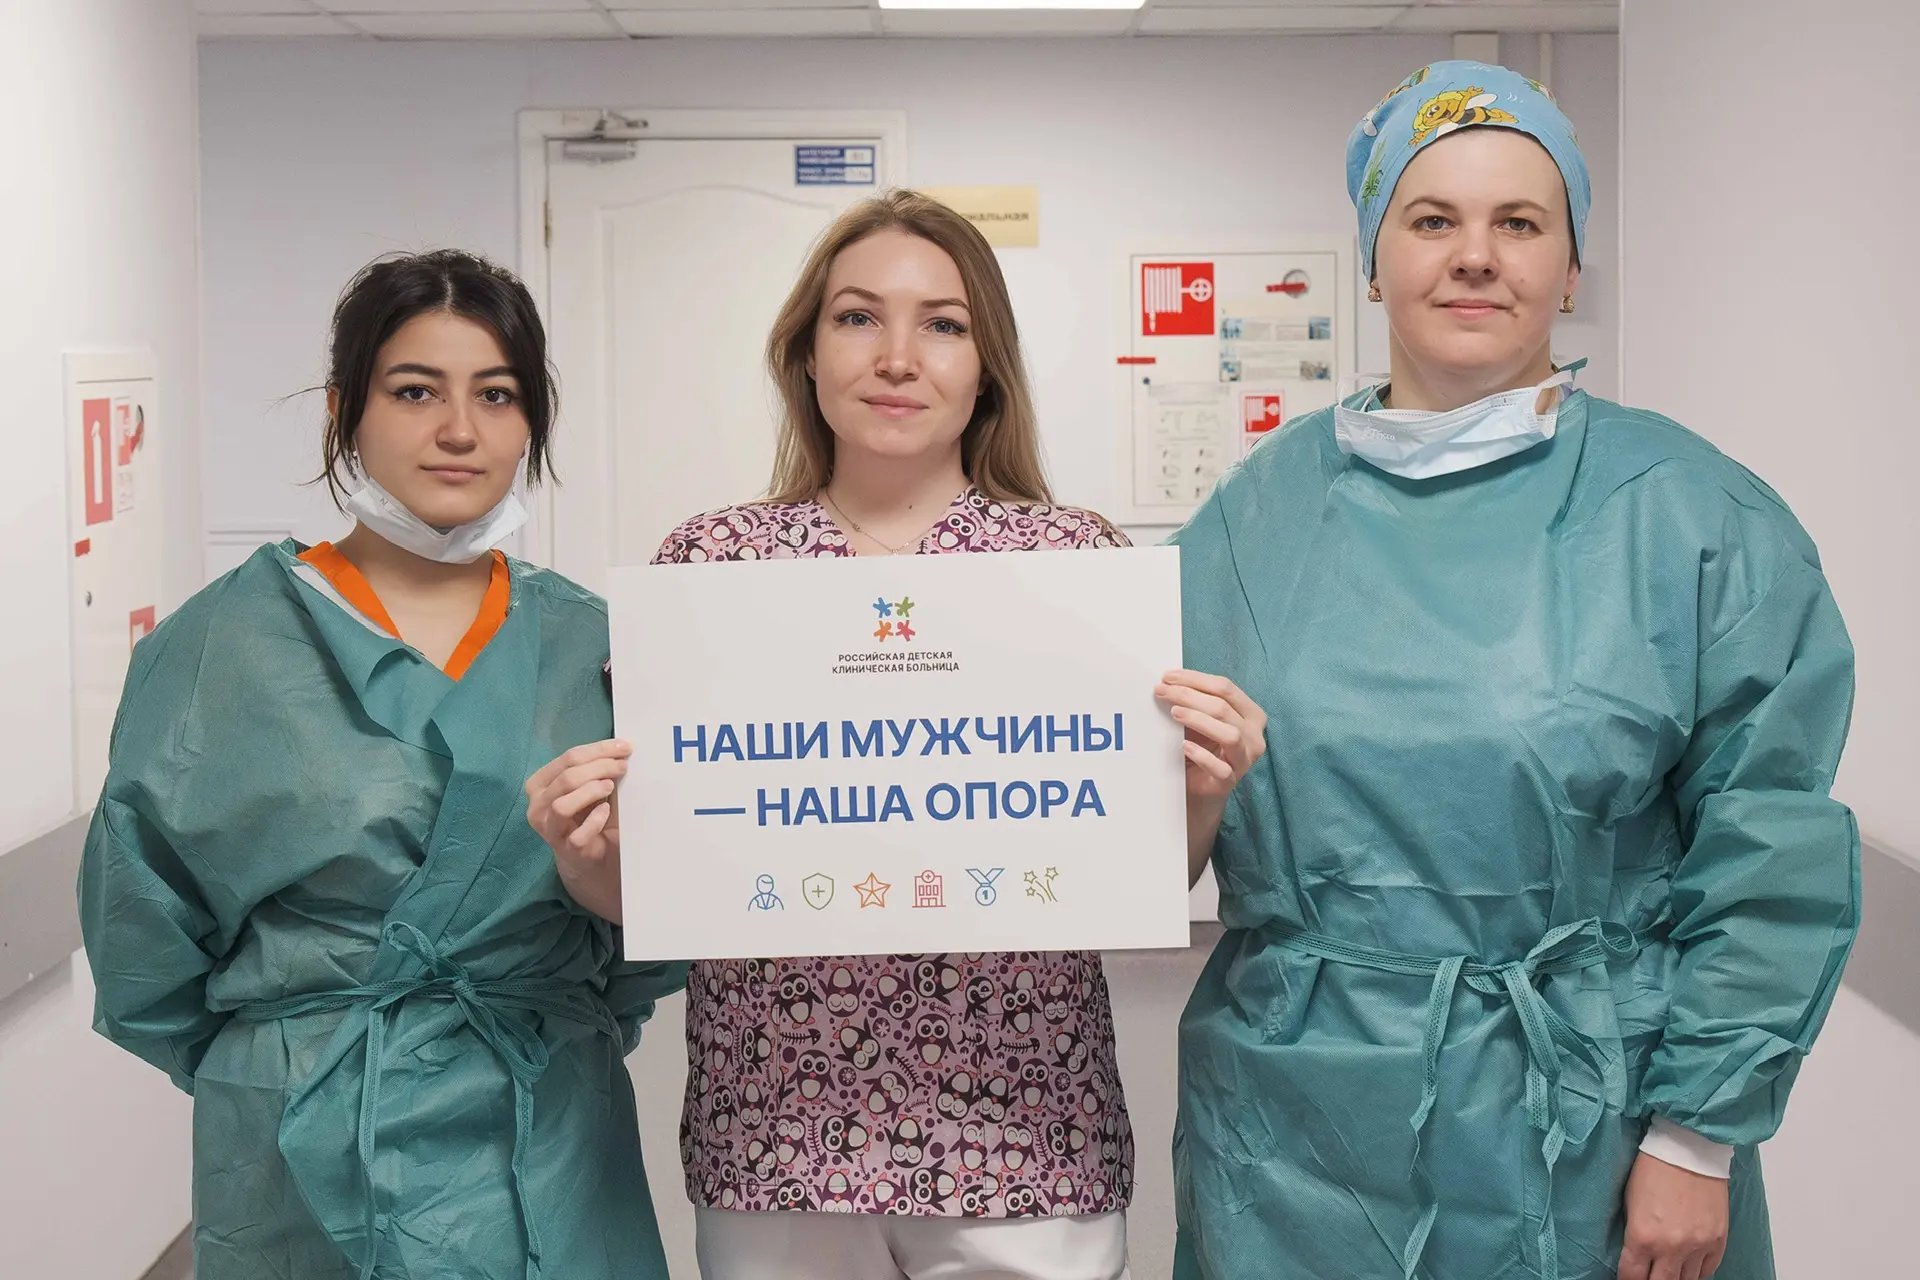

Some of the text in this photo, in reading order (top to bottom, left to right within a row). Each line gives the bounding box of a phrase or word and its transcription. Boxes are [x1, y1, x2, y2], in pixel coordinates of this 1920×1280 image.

[832, 662, 960, 674] КЛИНИЧЕСКАЯ БОЛЬНИЦА
[838, 651, 953, 662] РОССИЙСКАЯ ДЕТСКАЯ
[673, 713, 1124, 764] НАШИ МУЖЧИНЫ
[758, 784, 914, 826] НАША
[926, 779, 1107, 820] ОПОРА
